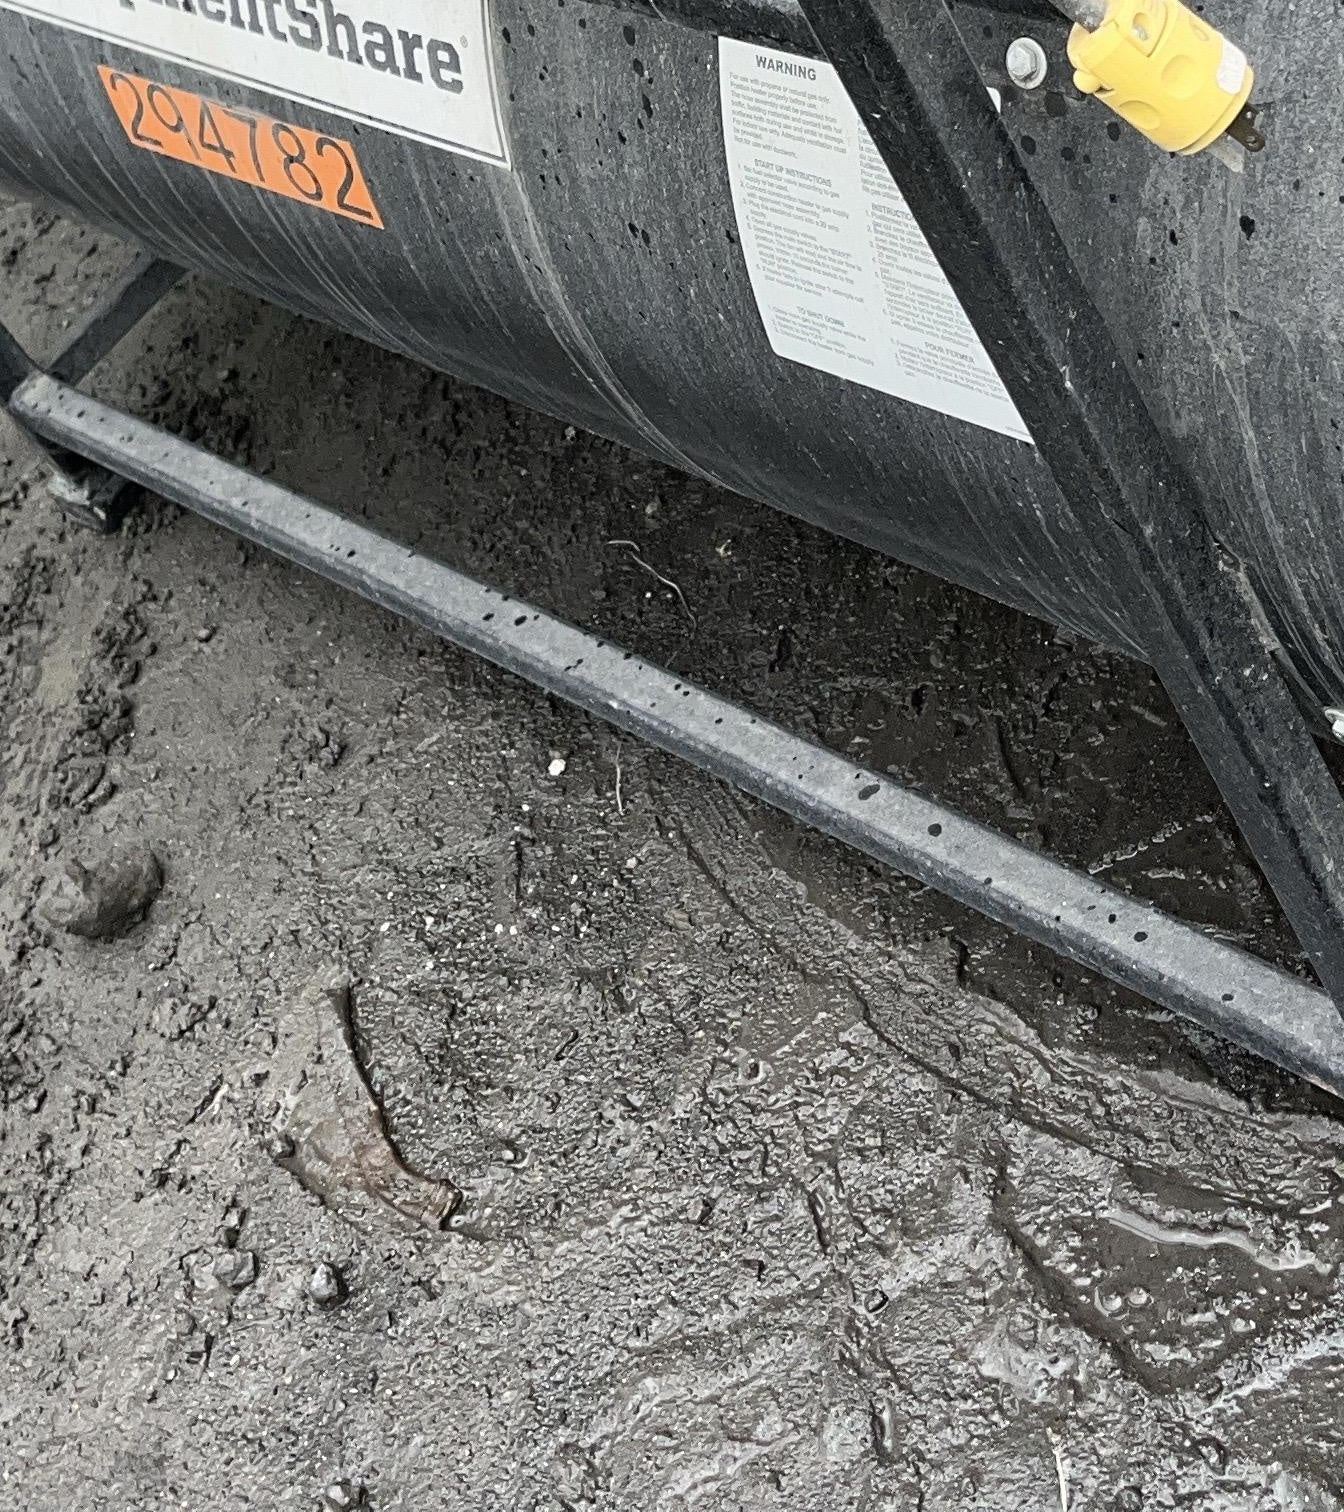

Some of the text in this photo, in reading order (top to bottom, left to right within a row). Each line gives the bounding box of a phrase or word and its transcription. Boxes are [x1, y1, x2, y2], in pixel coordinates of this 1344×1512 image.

[755, 54, 817, 81] WARNING
[109, 72, 373, 219] 294782
[871, 203, 914, 221] INSTRUCTIO
